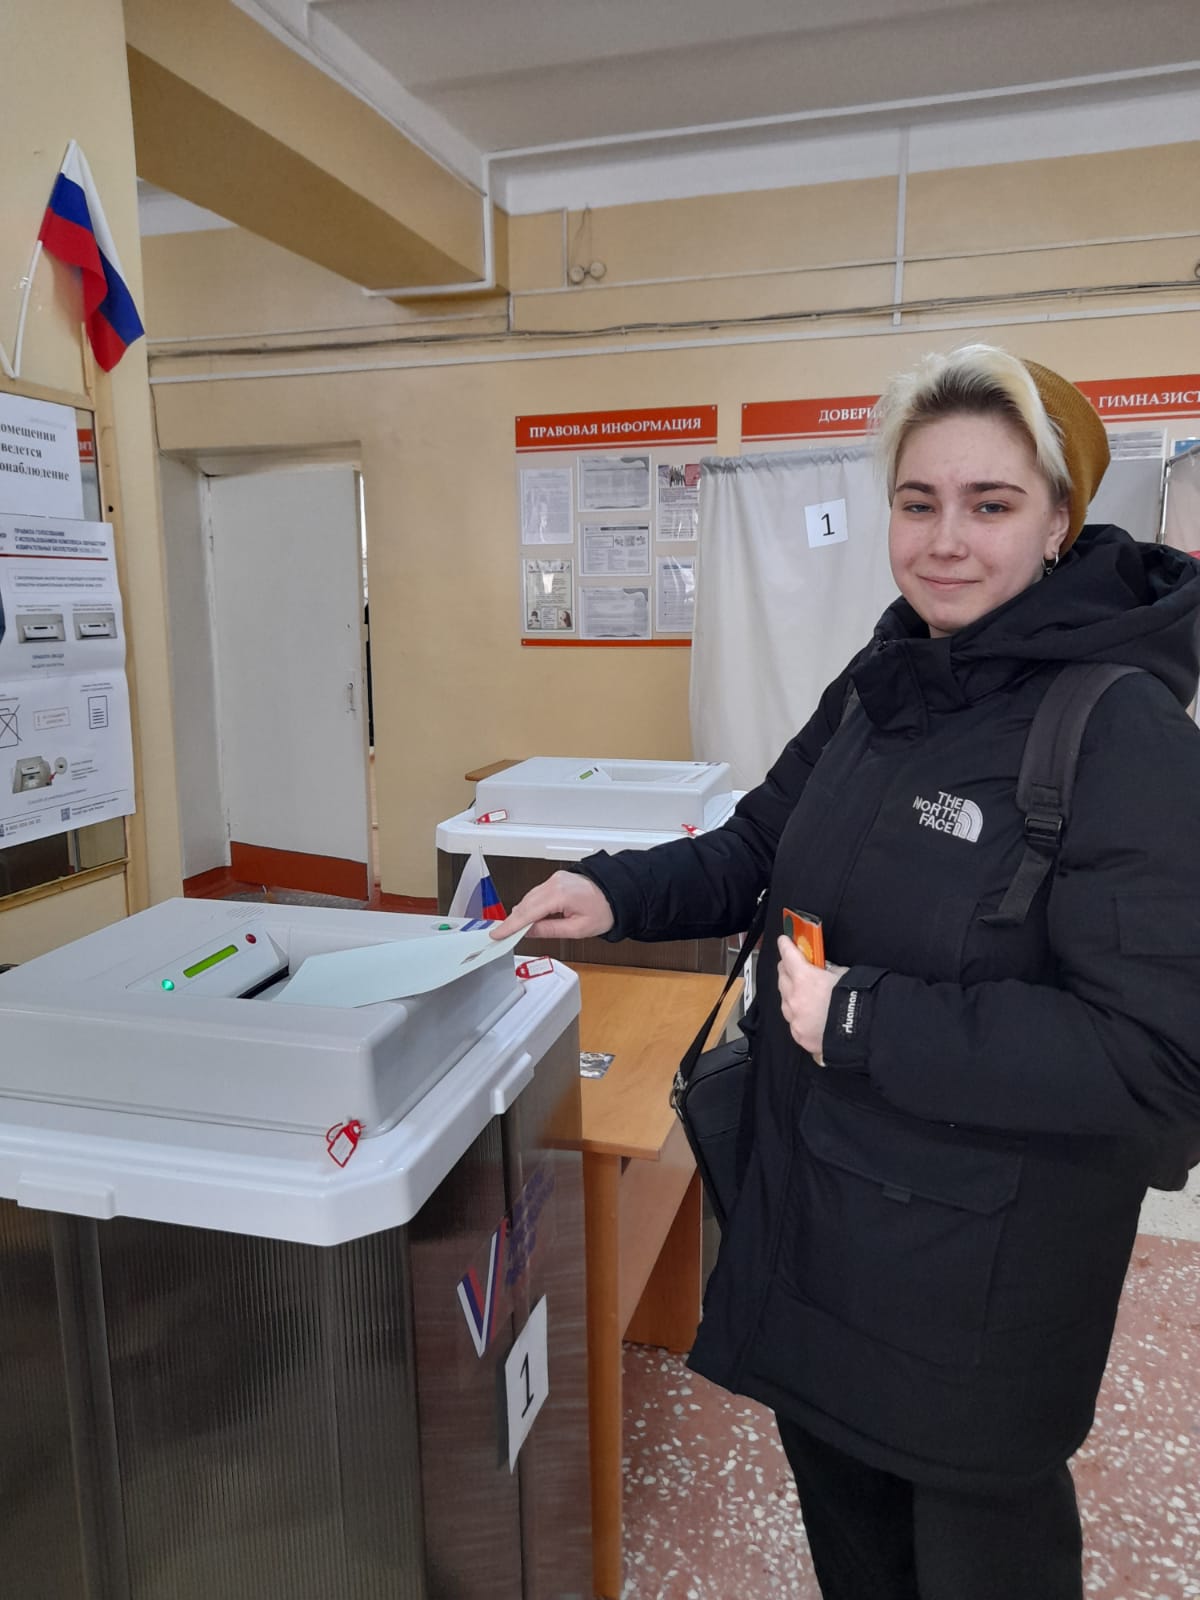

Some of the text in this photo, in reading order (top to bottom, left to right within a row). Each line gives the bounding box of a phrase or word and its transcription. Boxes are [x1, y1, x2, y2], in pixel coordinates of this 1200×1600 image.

[529, 417, 702, 439] ПРАВОВАЯ ИНФОРМАЦИЯ
[821, 513, 835, 536] 1
[912, 795, 960, 823] NORTH
[938, 791, 964, 810] THE
[918, 812, 954, 834] FACE
[520, 1352, 535, 1418] 1
